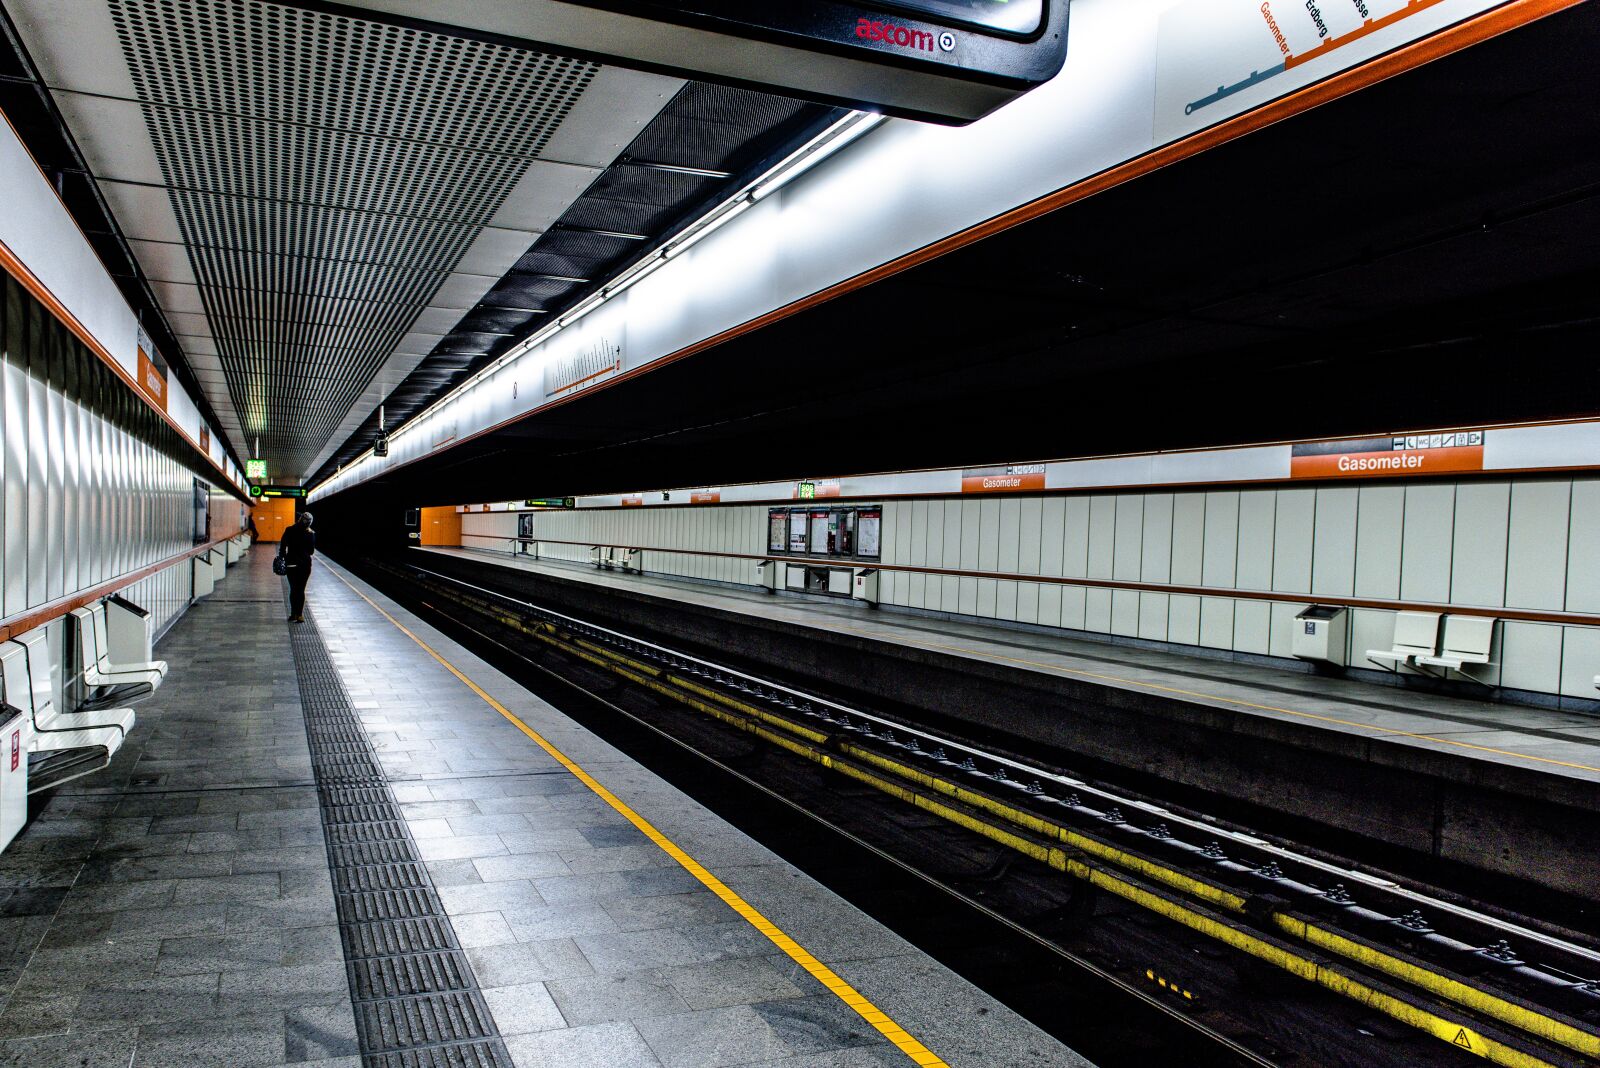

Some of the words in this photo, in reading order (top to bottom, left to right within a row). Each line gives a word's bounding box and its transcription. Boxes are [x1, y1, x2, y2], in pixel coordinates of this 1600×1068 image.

[855, 17, 934, 52] ascom
[1260, 1, 1291, 55] Gasometer
[1305, 0, 1328, 38] Erdberg
[1338, 453, 1425, 472] Gasometer
[983, 477, 1022, 489] Gasometer
